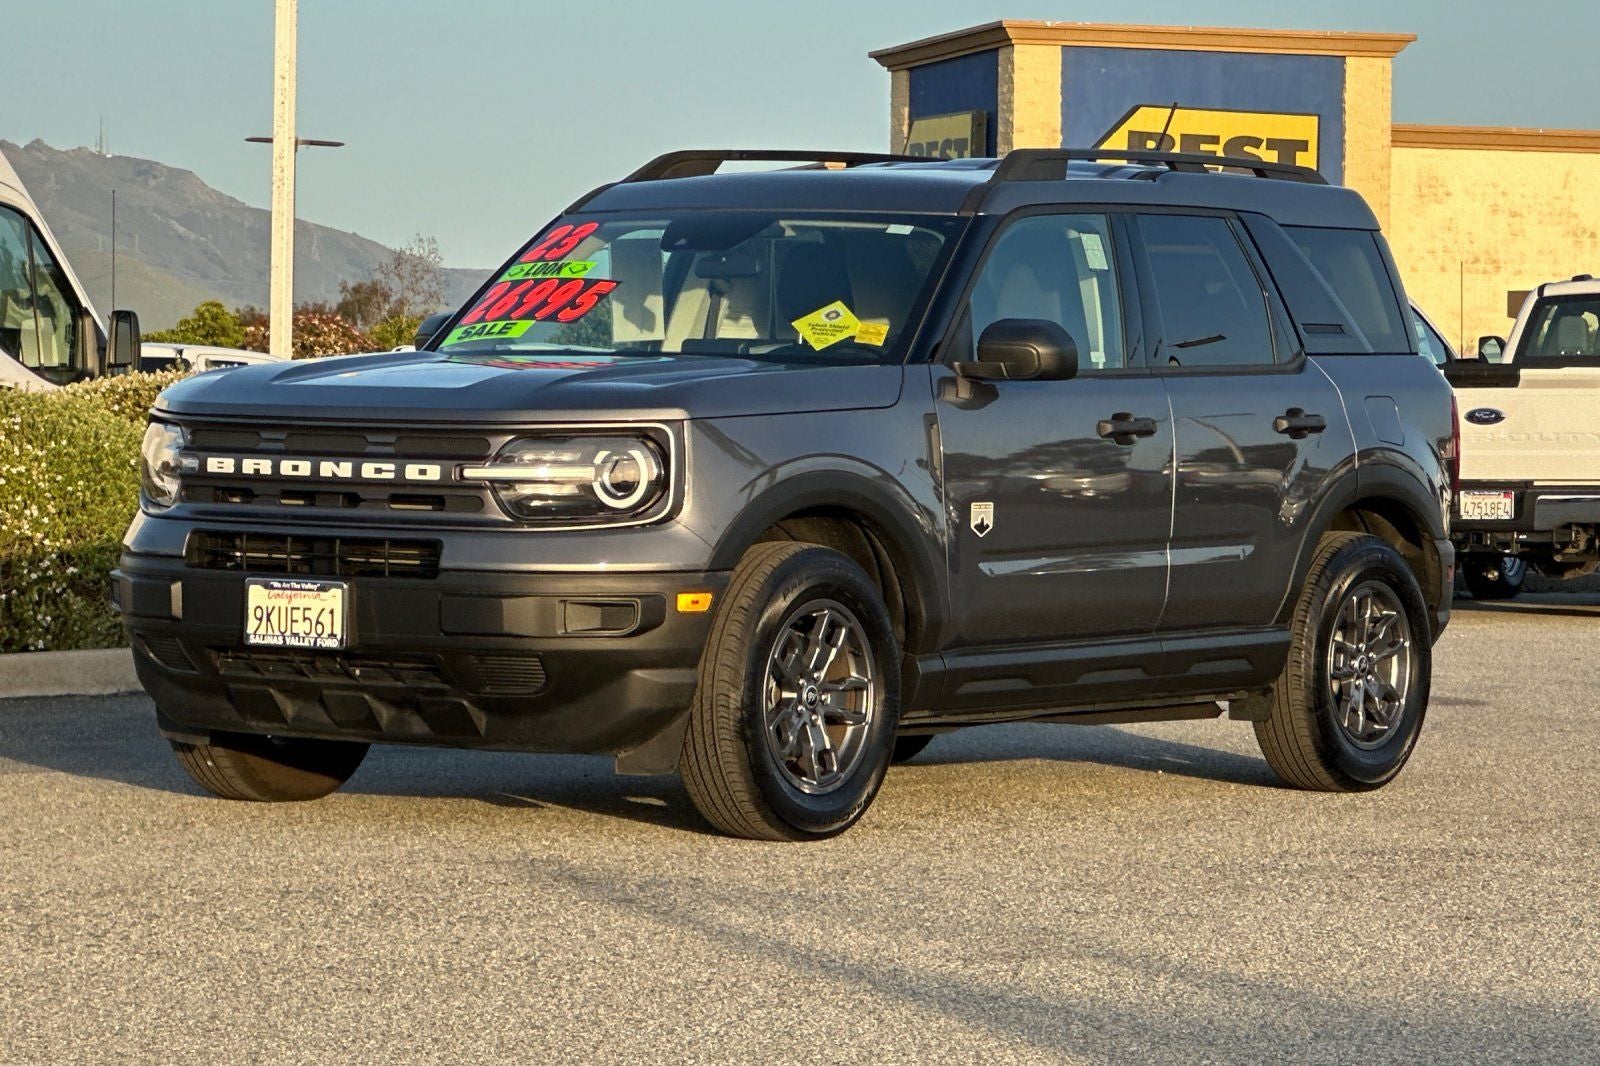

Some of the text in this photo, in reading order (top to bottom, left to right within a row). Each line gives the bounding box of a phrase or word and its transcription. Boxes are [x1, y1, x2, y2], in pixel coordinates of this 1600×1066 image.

[1127, 130, 1309, 174] BEST
[520, 221, 600, 263] 23
[523, 262, 573, 277] LOOK
[459, 279, 619, 324] 26995
[457, 322, 517, 339] SALE
[206, 456, 441, 481] BRONCO
[1463, 501, 1510, 516] 47518F4
[267, 590, 321, 605] California
[253, 605, 337, 637] 9KUE561
[249, 635, 339, 648] SALINAS VALLEY FORD
